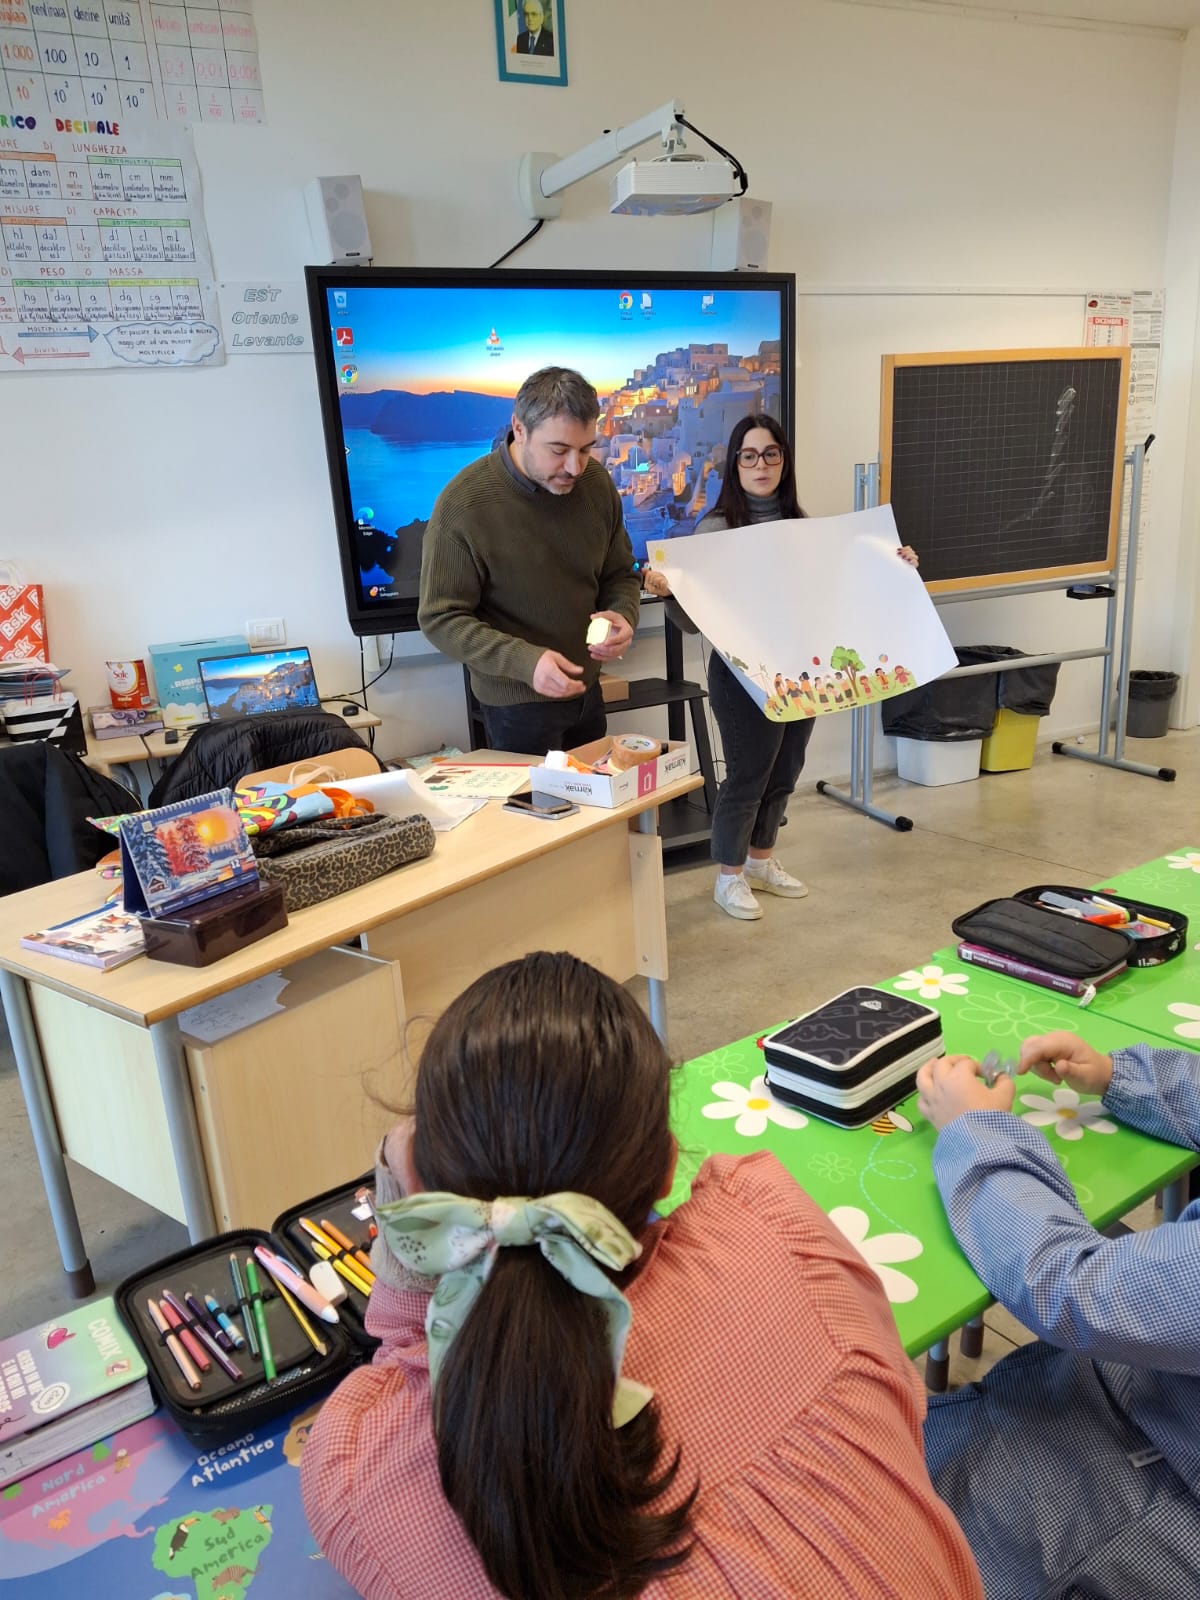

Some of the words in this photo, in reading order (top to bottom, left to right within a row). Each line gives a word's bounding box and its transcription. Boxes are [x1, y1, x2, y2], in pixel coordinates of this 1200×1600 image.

[45, 48, 67, 64] 100
[84, 52, 99, 66] 10
[55, 118, 120, 136] DECIMALE
[72, 143, 127, 154] LUNGHEZZA
[30, 164, 51, 177] dam
[69, 170, 78, 178] m
[97, 168, 112, 180] dm
[4, 205, 41, 214] MISURE
[40, 267, 66, 277] PESO
[85, 268, 92, 276] O
[108, 268, 144, 277] MASSA
[24, 289, 37, 304] hg
[54, 289, 71, 304] dag
[90, 295, 97, 304] g
[120, 289, 132, 303] dg
[176, 294, 190, 303] mg
[243, 288, 282, 303] EST
[231, 311, 300, 325] Oriente
[231, 333, 305, 347] Levante
[1, 606, 31, 639] Bsk
[230, 860, 240, 869] 12
[197, 1433, 255, 1467] Oceano
[191, 1439, 275, 1488] Atlantico
[41, 1463, 85, 1494] Nord
[31, 1475, 106, 1519] America
[204, 1526, 236, 1552] Sud
[191, 1534, 265, 1580] America
